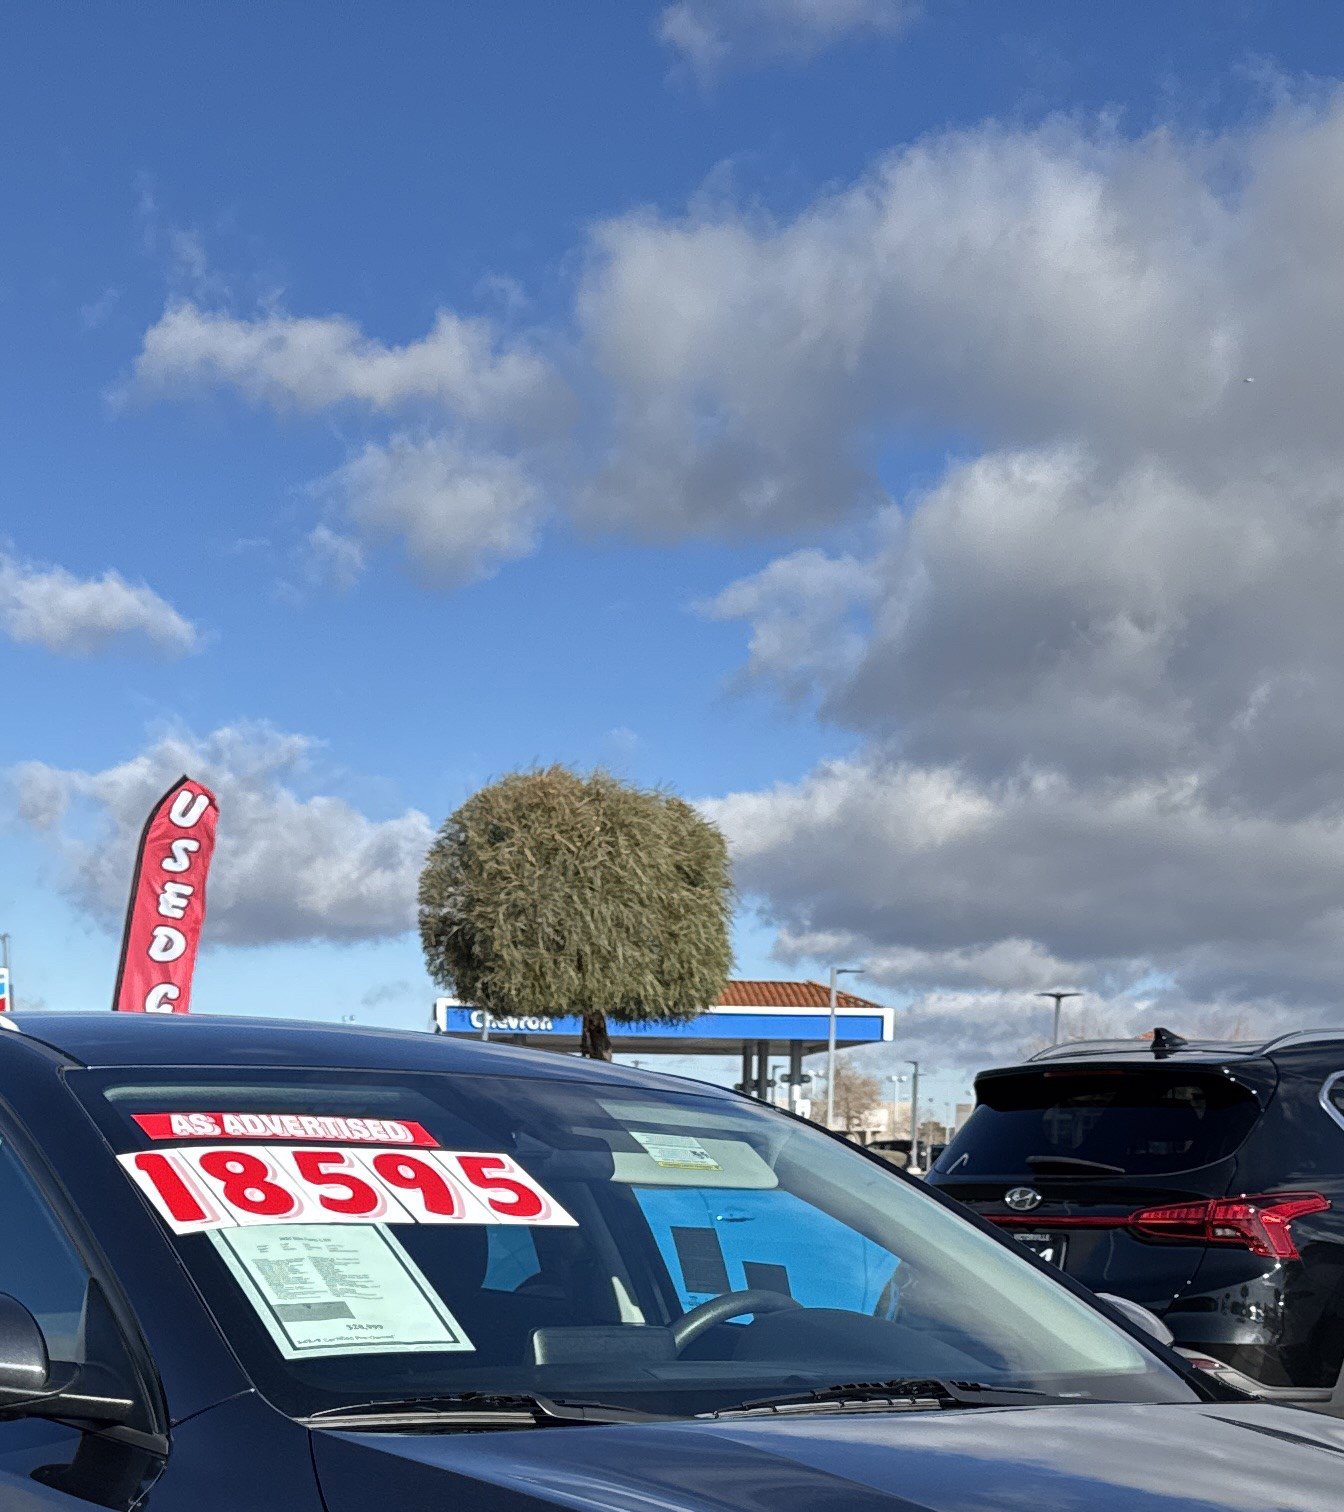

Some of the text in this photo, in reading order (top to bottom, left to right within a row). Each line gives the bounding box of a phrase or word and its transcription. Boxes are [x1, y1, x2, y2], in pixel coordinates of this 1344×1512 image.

[147, 789, 210, 963] USED
[470, 1010, 554, 1031] Chevron
[170, 1113, 415, 1143] AS ADVERTISED
[134, 1151, 548, 1224] 18595
